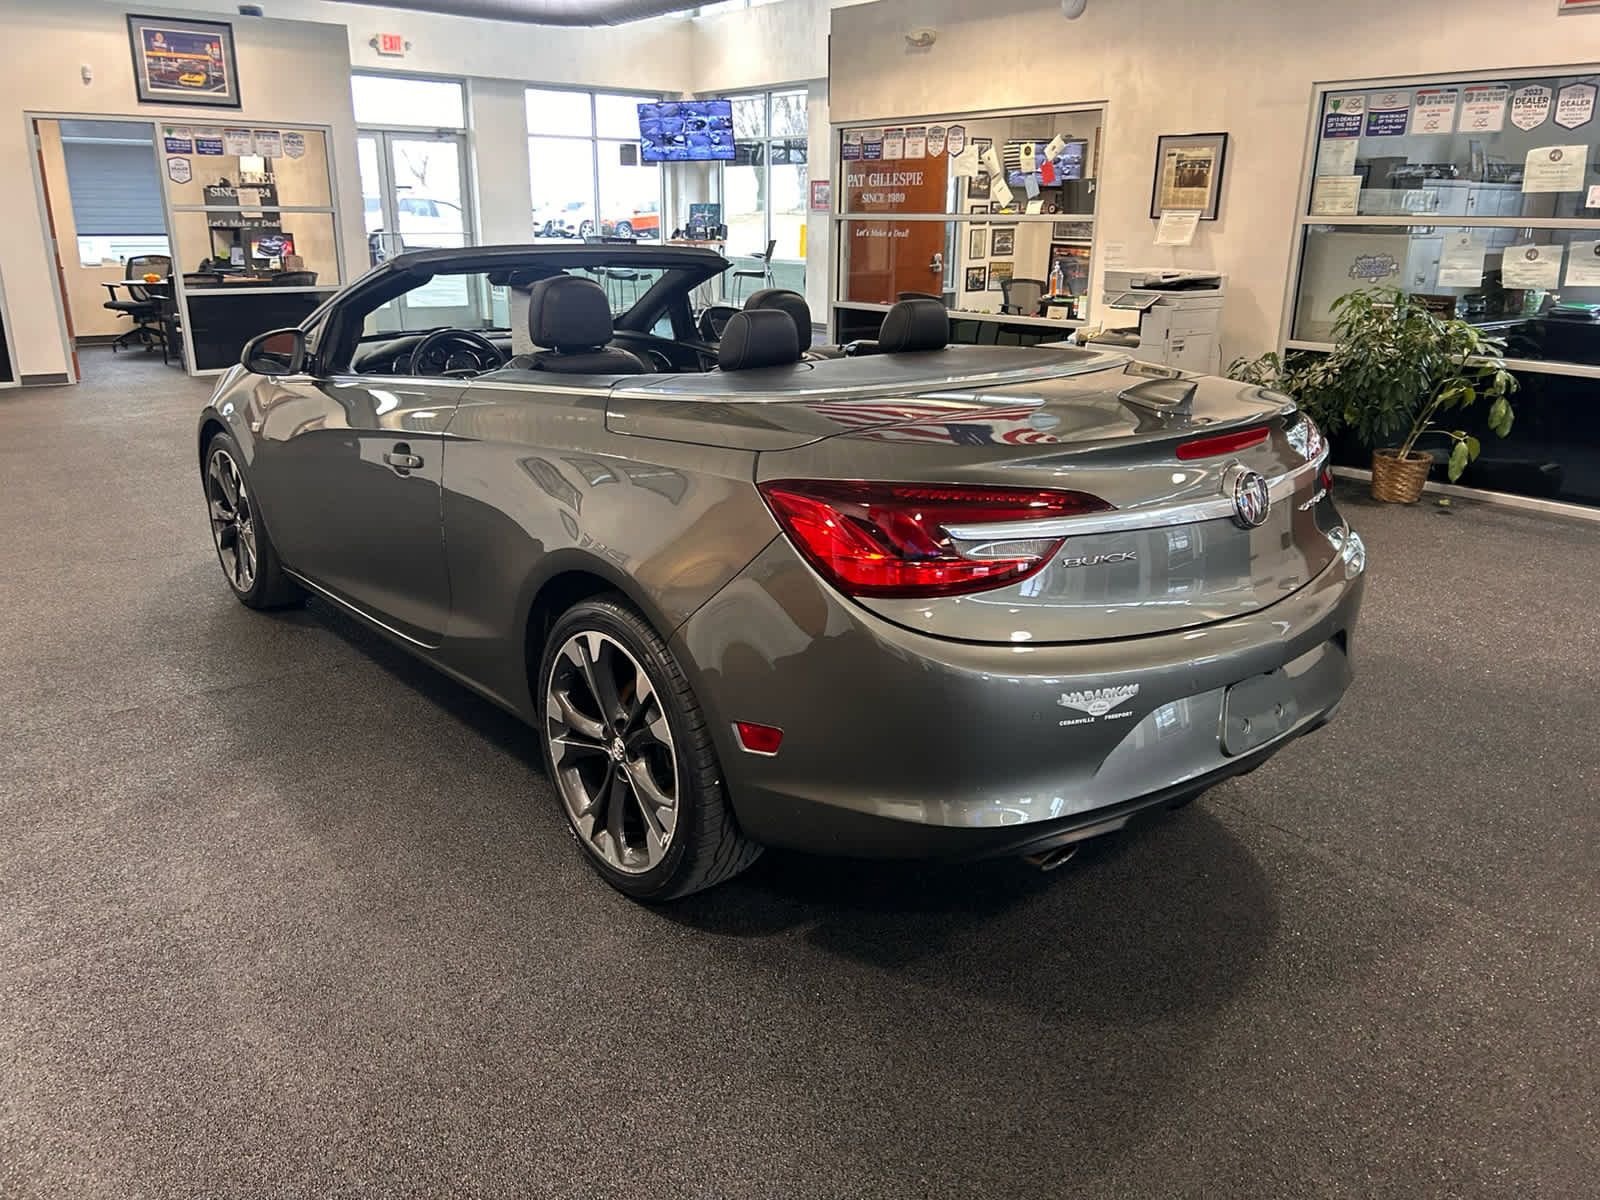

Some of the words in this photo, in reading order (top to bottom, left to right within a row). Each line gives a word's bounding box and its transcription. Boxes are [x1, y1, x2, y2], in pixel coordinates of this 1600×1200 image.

[1515, 96, 1549, 105] DEALER
[848, 174, 865, 187] PAT
[868, 171, 924, 187] GILLESPIE
[210, 187, 237, 198] SINC
[862, 192, 884, 203] SINCE
[208, 219, 227, 227] Let's
[230, 219, 252, 227] Make
[1063, 551, 1137, 568] BUICK
[1059, 717, 1095, 727] CEDARVILLE
[1104, 711, 1133, 721] FREEPORT
